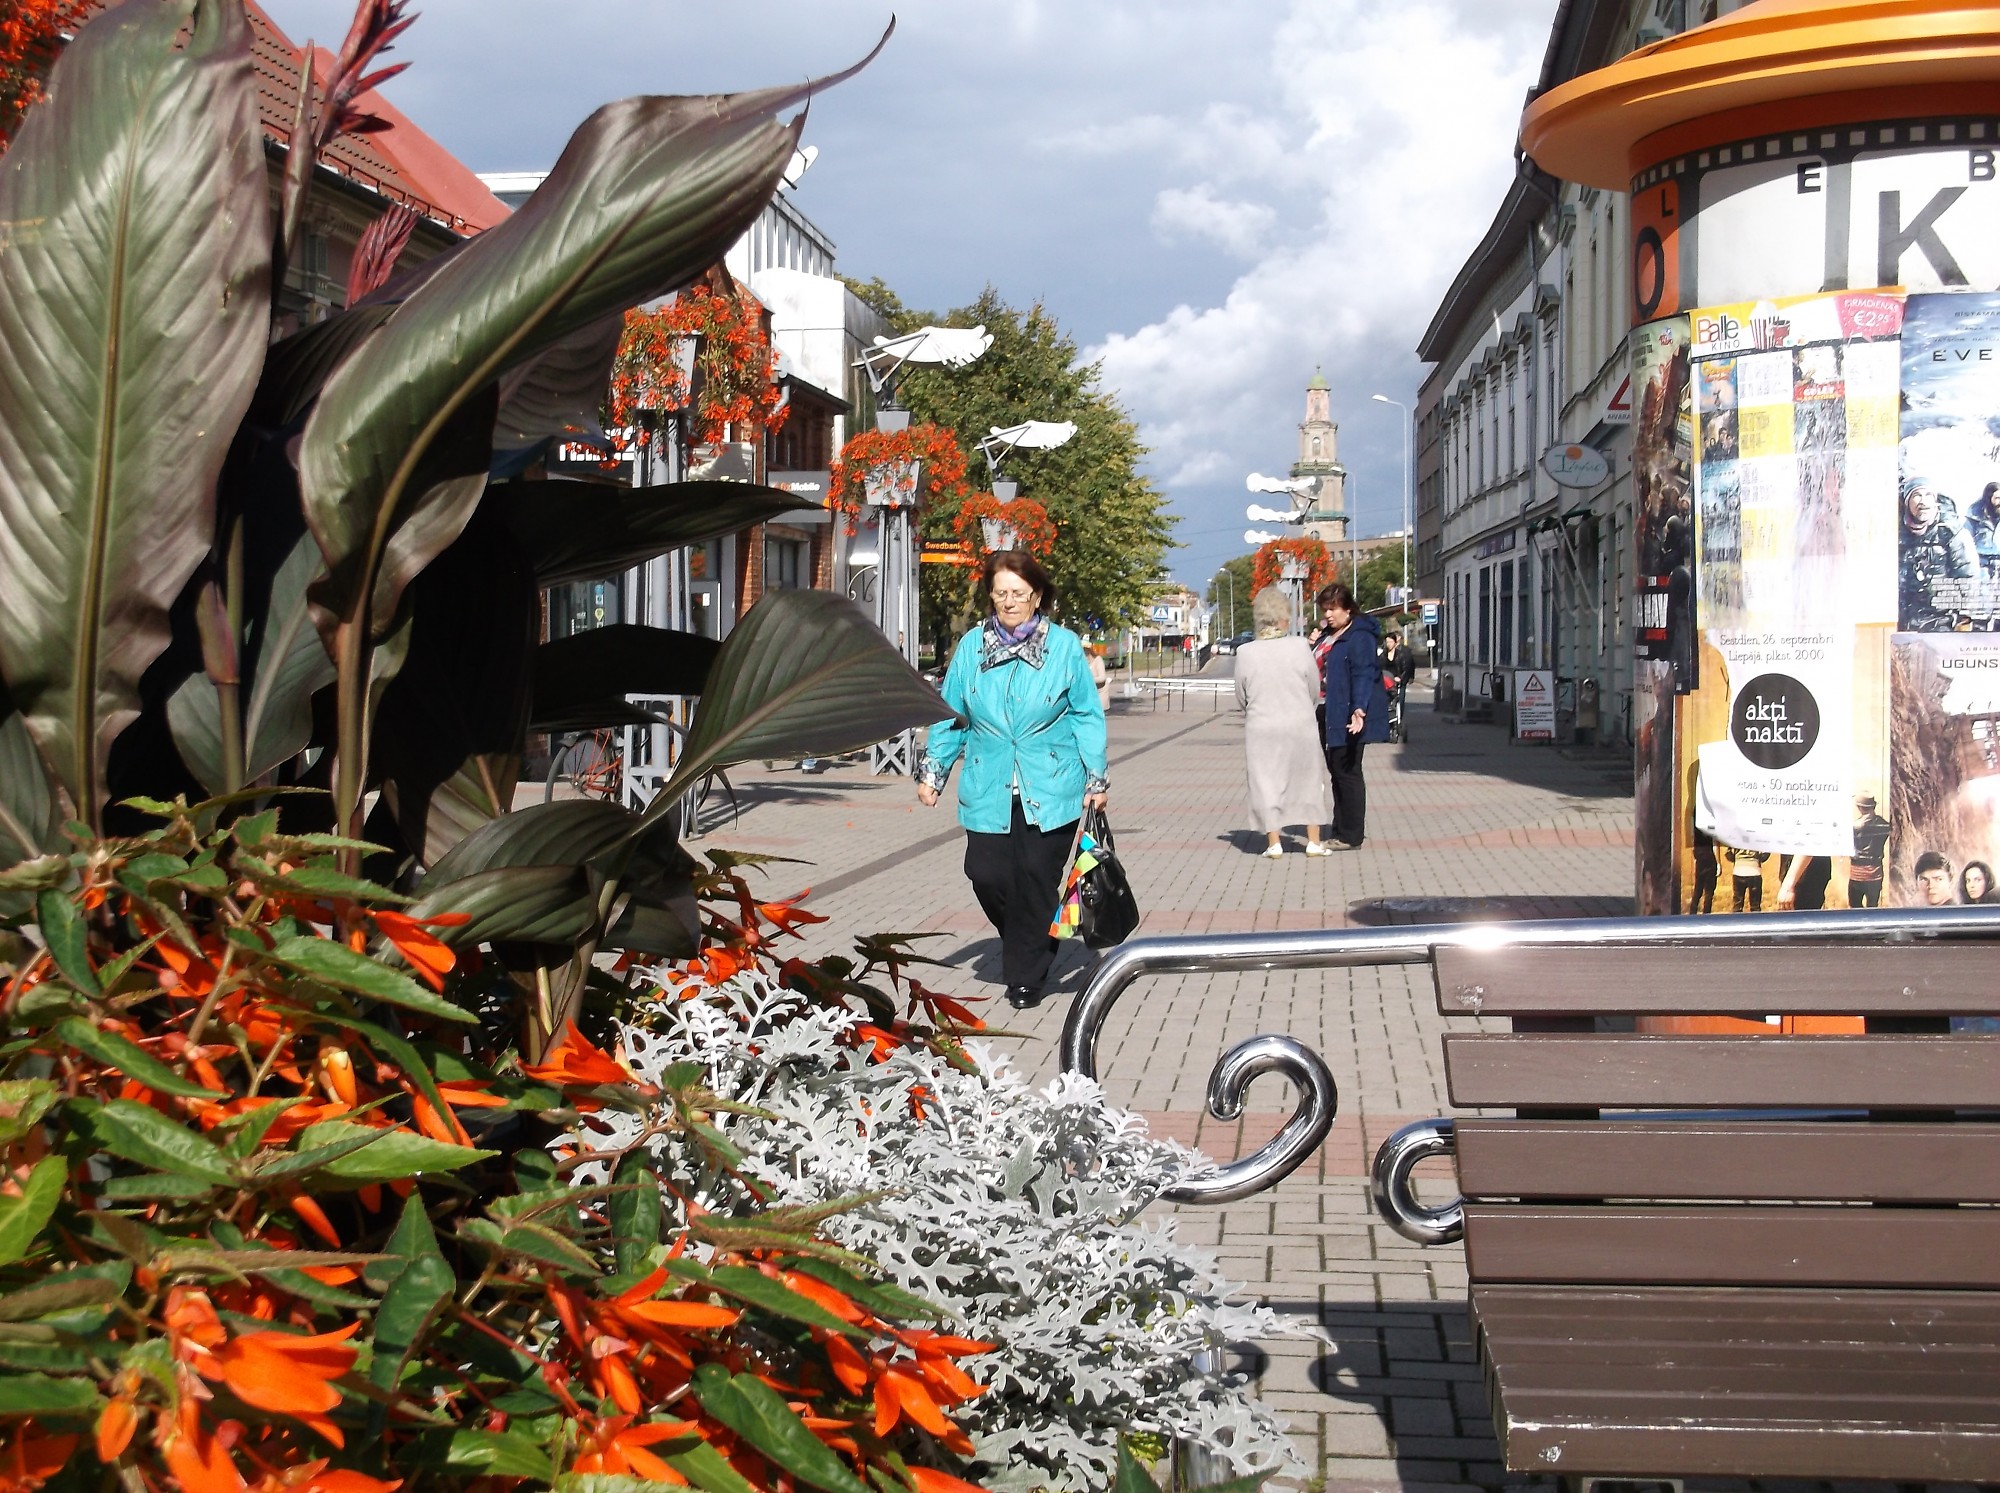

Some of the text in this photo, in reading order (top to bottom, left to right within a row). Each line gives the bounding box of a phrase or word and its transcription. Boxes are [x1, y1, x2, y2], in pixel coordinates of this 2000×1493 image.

[1661, 150, 1996, 217] L E B
[1635, 186, 1969, 320] O K
[1697, 315, 1739, 345] Balle
[1711, 339, 1740, 352] KINO
[1762, 633, 1776, 645] 26
[1744, 719, 1804, 744] naktī
[1769, 778, 1782, 791] 50
[1785, 779, 1839, 792] notikumi
